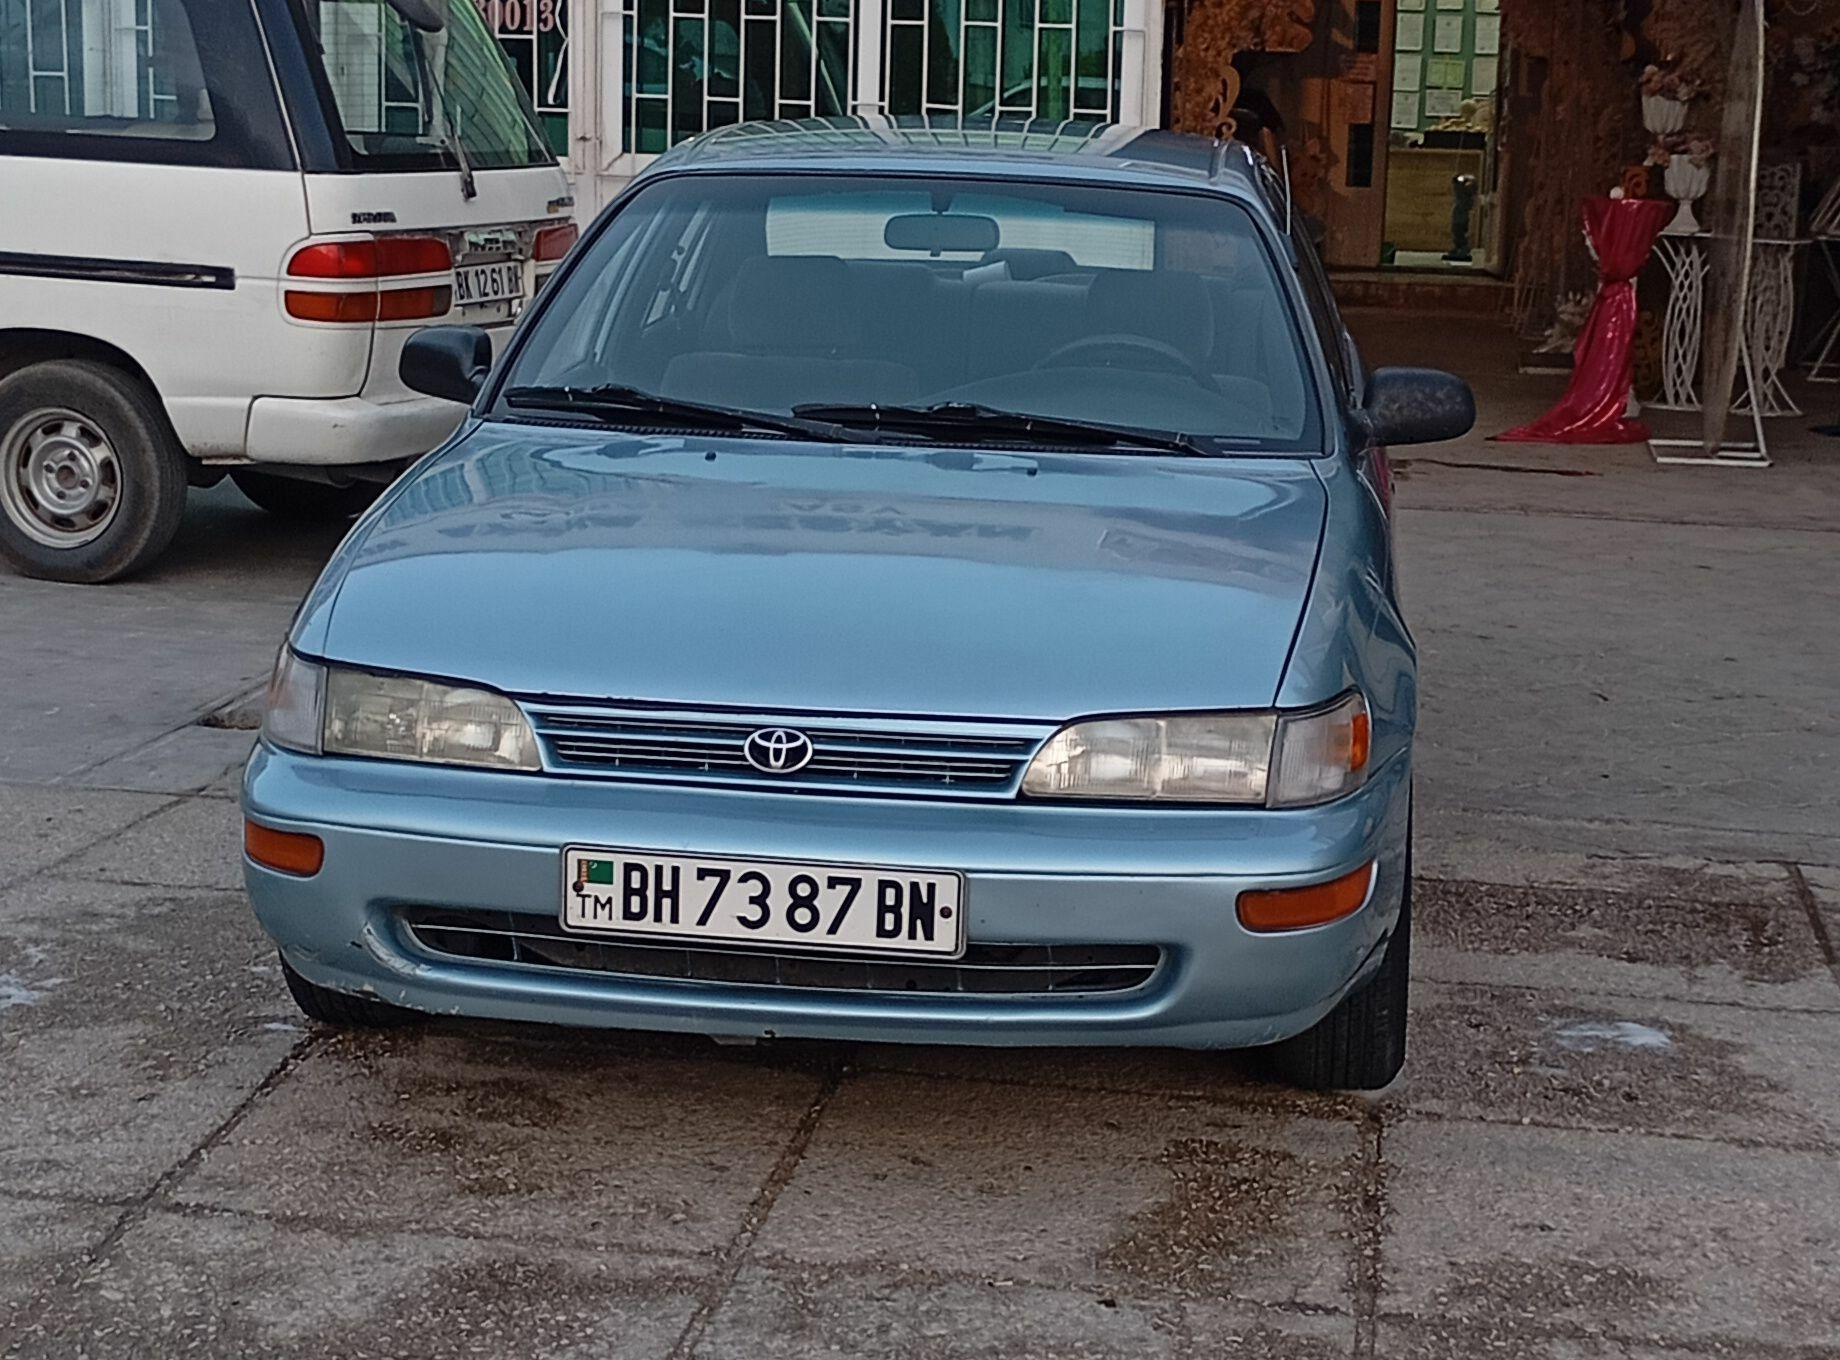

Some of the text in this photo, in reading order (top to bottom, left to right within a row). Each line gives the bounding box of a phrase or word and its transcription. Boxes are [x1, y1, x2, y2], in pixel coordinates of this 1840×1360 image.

[576, 893, 613, 921] TM
[621, 861, 680, 925] BH
[876, 878, 936, 941] BN
